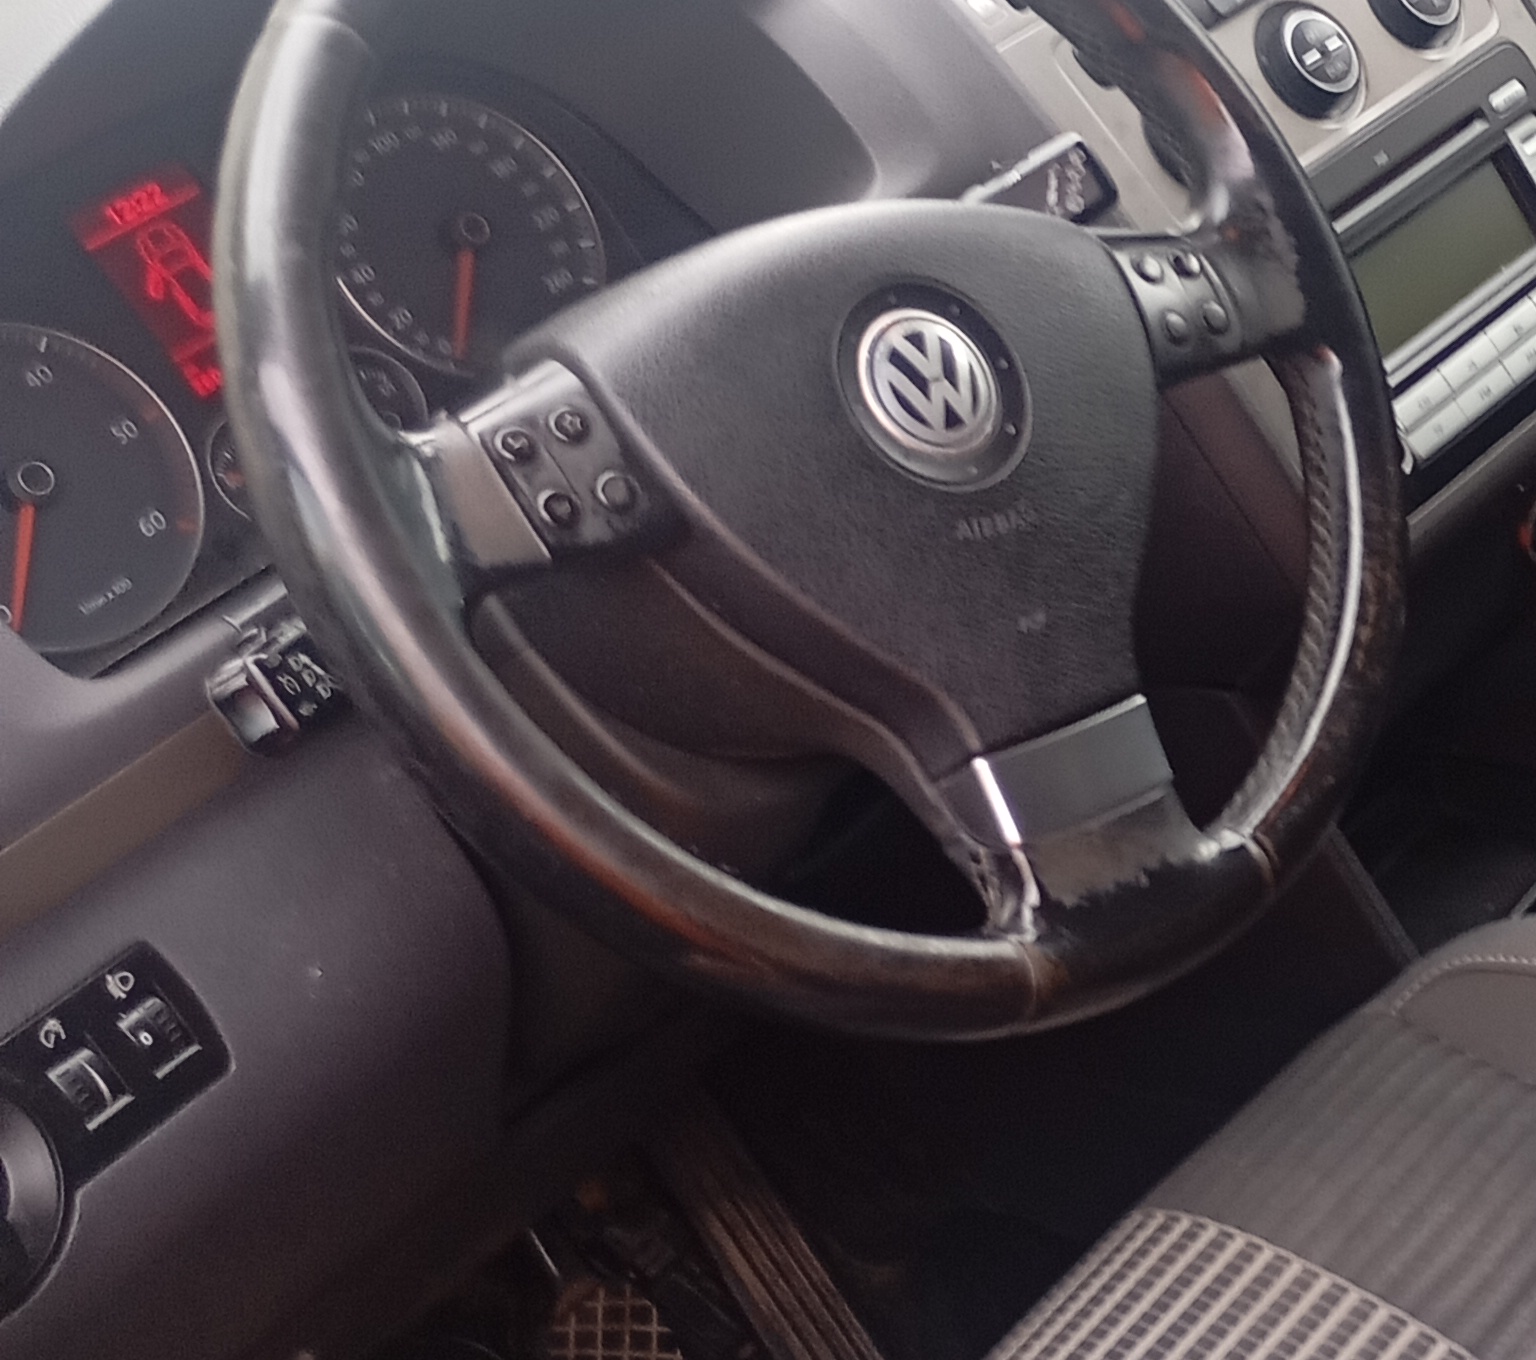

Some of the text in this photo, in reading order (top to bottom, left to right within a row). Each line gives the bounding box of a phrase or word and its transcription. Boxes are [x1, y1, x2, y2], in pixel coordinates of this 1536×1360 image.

[25, 364, 53, 388] 40
[110, 418, 139, 445] 50
[138, 509, 167, 538] 60
